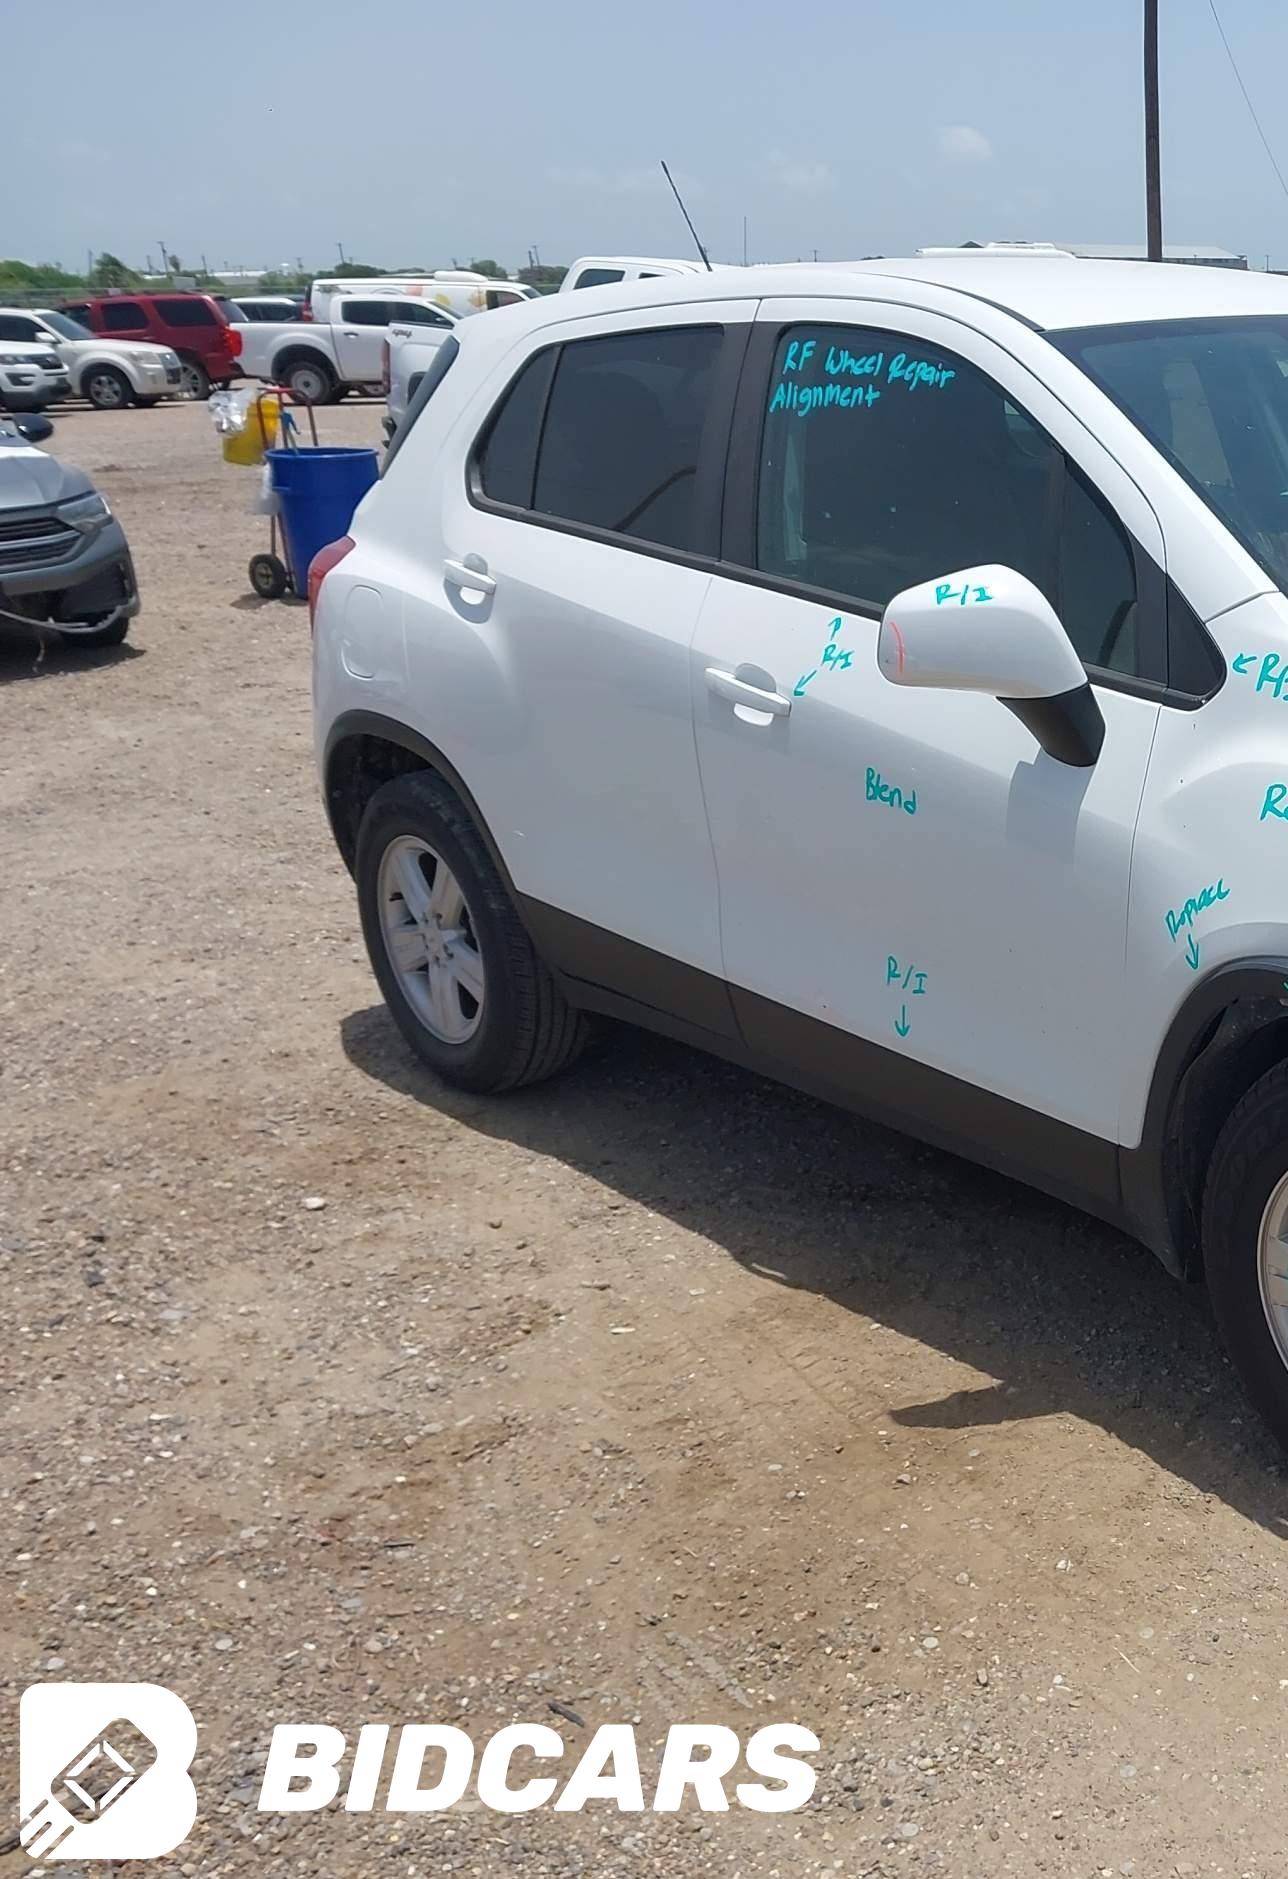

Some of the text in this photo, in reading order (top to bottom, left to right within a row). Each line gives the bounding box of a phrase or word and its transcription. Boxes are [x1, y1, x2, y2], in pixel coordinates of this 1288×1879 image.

[783, 340, 956, 391] RF Wheel Repair
[769, 381, 881, 417] Alignment
[935, 584, 993, 606] R/I
[820, 643, 855, 671] R/I
[866, 767, 916, 815] Blend
[887, 955, 928, 994] R/I
